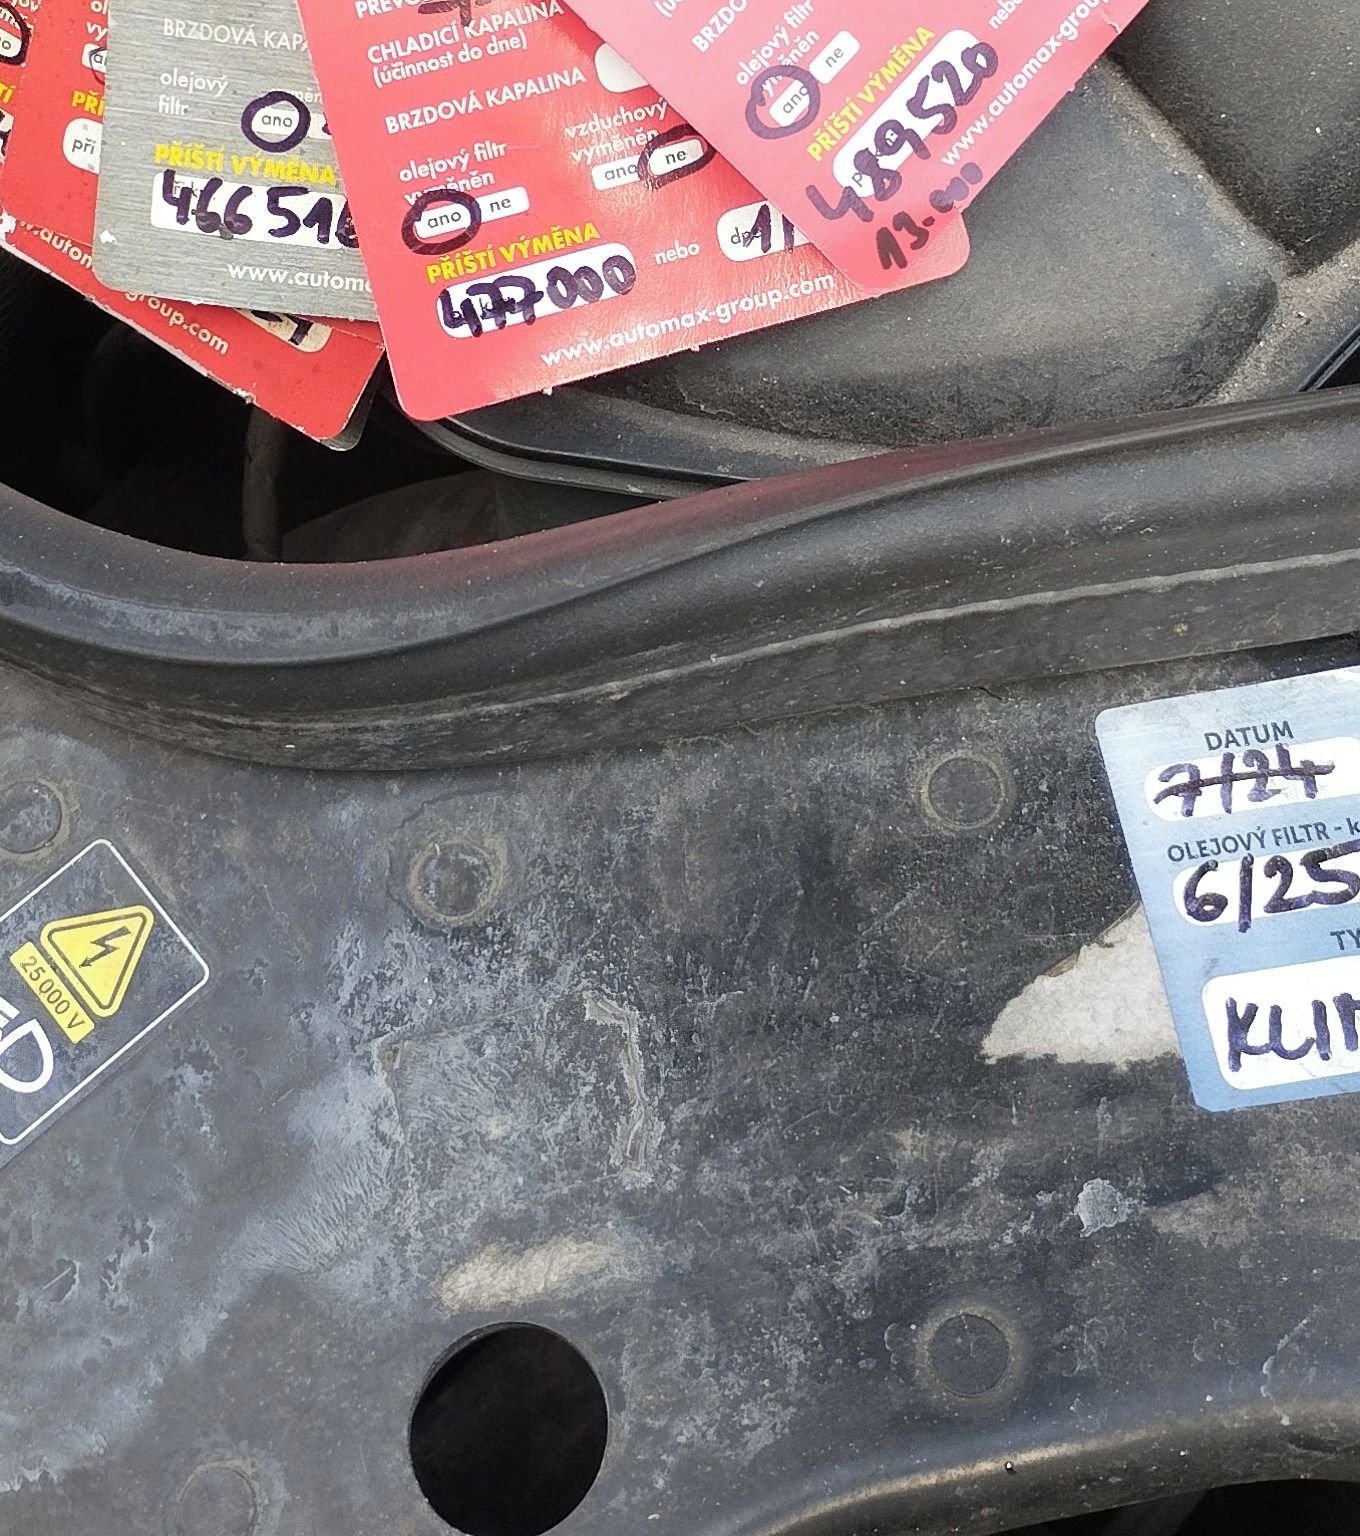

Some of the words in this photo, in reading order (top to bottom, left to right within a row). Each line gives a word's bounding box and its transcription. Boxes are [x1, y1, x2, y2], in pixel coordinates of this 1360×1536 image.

[163, 17, 258, 48] BRZDOVÁ
[366, 19, 461, 66] CHLADICÍ
[459, 41, 485, 66] do
[734, 24, 789, 87] olejový
[823, 44, 846, 70] ne
[159, 66, 229, 98] olejový
[804, 93, 861, 164] PŘÍŠTÍ
[853, 23, 938, 107] VÝMĚNA
[157, 93, 190, 116] filtr
[384, 90, 485, 136] BRZDOVÁ
[487, 66, 588, 111] KAPALINA
[260, 113, 293, 128] ano
[563, 99, 669, 140] vzduchový
[152, 139, 226, 172] PŘÍŠTÍ
[231, 147, 338, 186] VÝMĚNA
[398, 148, 471, 184] olejový
[473, 139, 508, 165] filtr
[603, 162, 639, 181] ano
[664, 147, 688, 165] ne
[426, 210, 463, 230] ano
[487, 195, 513, 212] ne
[425, 248, 498, 285] PŘÍŠTÍ
[498, 222, 601, 267] VÝMĚNA
[654, 240, 701, 265] nebo
[541, 271, 837, 367] www.automax-group.com
[1203, 719, 1295, 752] DATUM
[1166, 824, 1267, 863] OLEJOVÝ
[1271, 820, 1331, 848] FILTR
[64, 1012, 85, 1032] V
